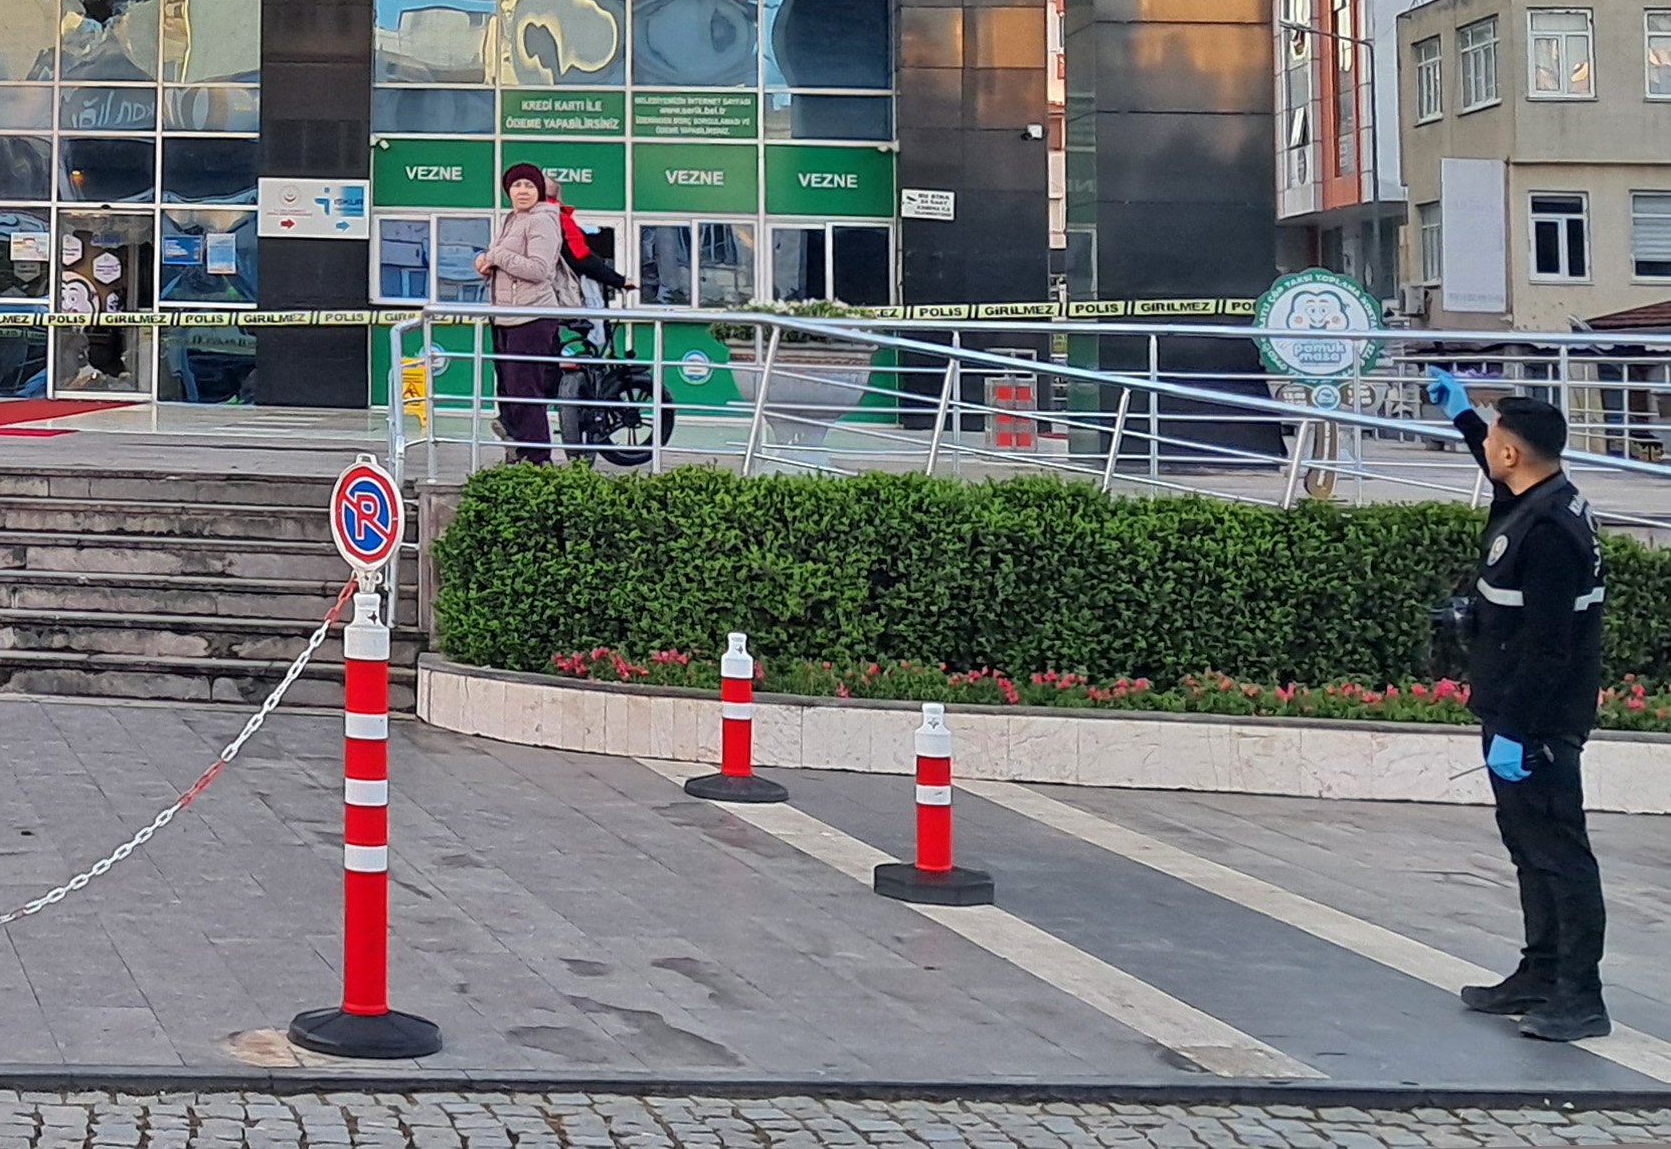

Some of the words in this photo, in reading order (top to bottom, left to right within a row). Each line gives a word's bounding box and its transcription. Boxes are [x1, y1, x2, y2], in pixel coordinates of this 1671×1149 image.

[521, 98, 552, 111] KREDİ
[554, 101, 584, 111] KARTI
[586, 98, 602, 111] İLE
[506, 116, 541, 129] ÖDEME
[543, 117, 619, 129] YAPABİLİRSİNİZ
[405, 166, 463, 181] VEZNE
[665, 169, 725, 185] VEZNE
[798, 173, 858, 188] VEZNE
[1294, 340, 1345, 356] pamuk
